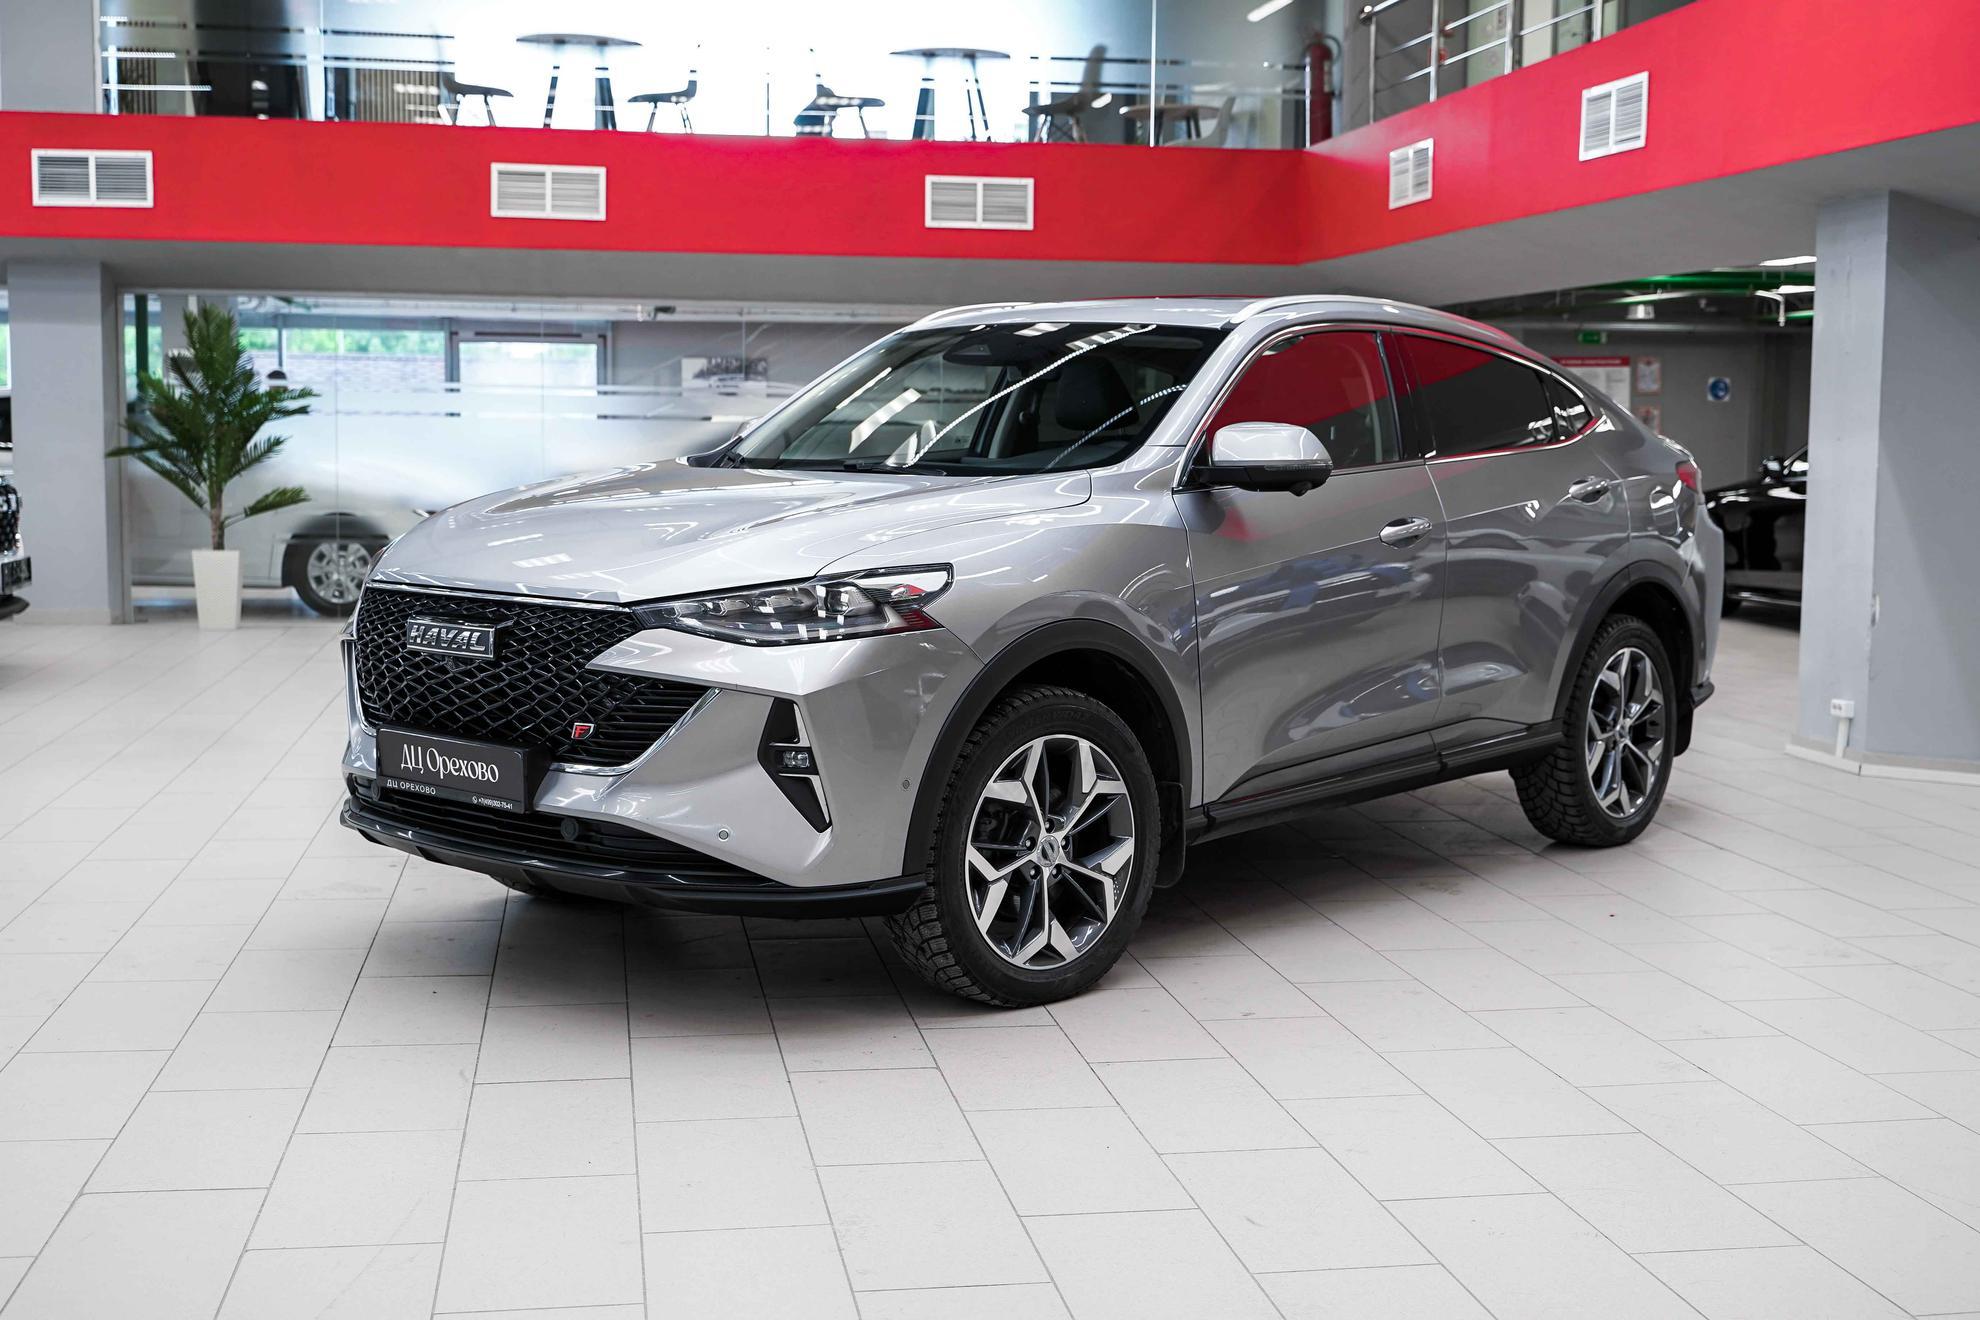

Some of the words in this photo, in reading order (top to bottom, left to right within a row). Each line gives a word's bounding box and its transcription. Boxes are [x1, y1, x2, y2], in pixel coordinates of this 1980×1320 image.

[409, 624, 486, 651] HAVAL
[400, 743, 424, 774] ДЦ
[426, 747, 499, 783] Орехово
[386, 779, 398, 789] ДЦ
[399, 781, 437, 795] ОРЕХОВО
